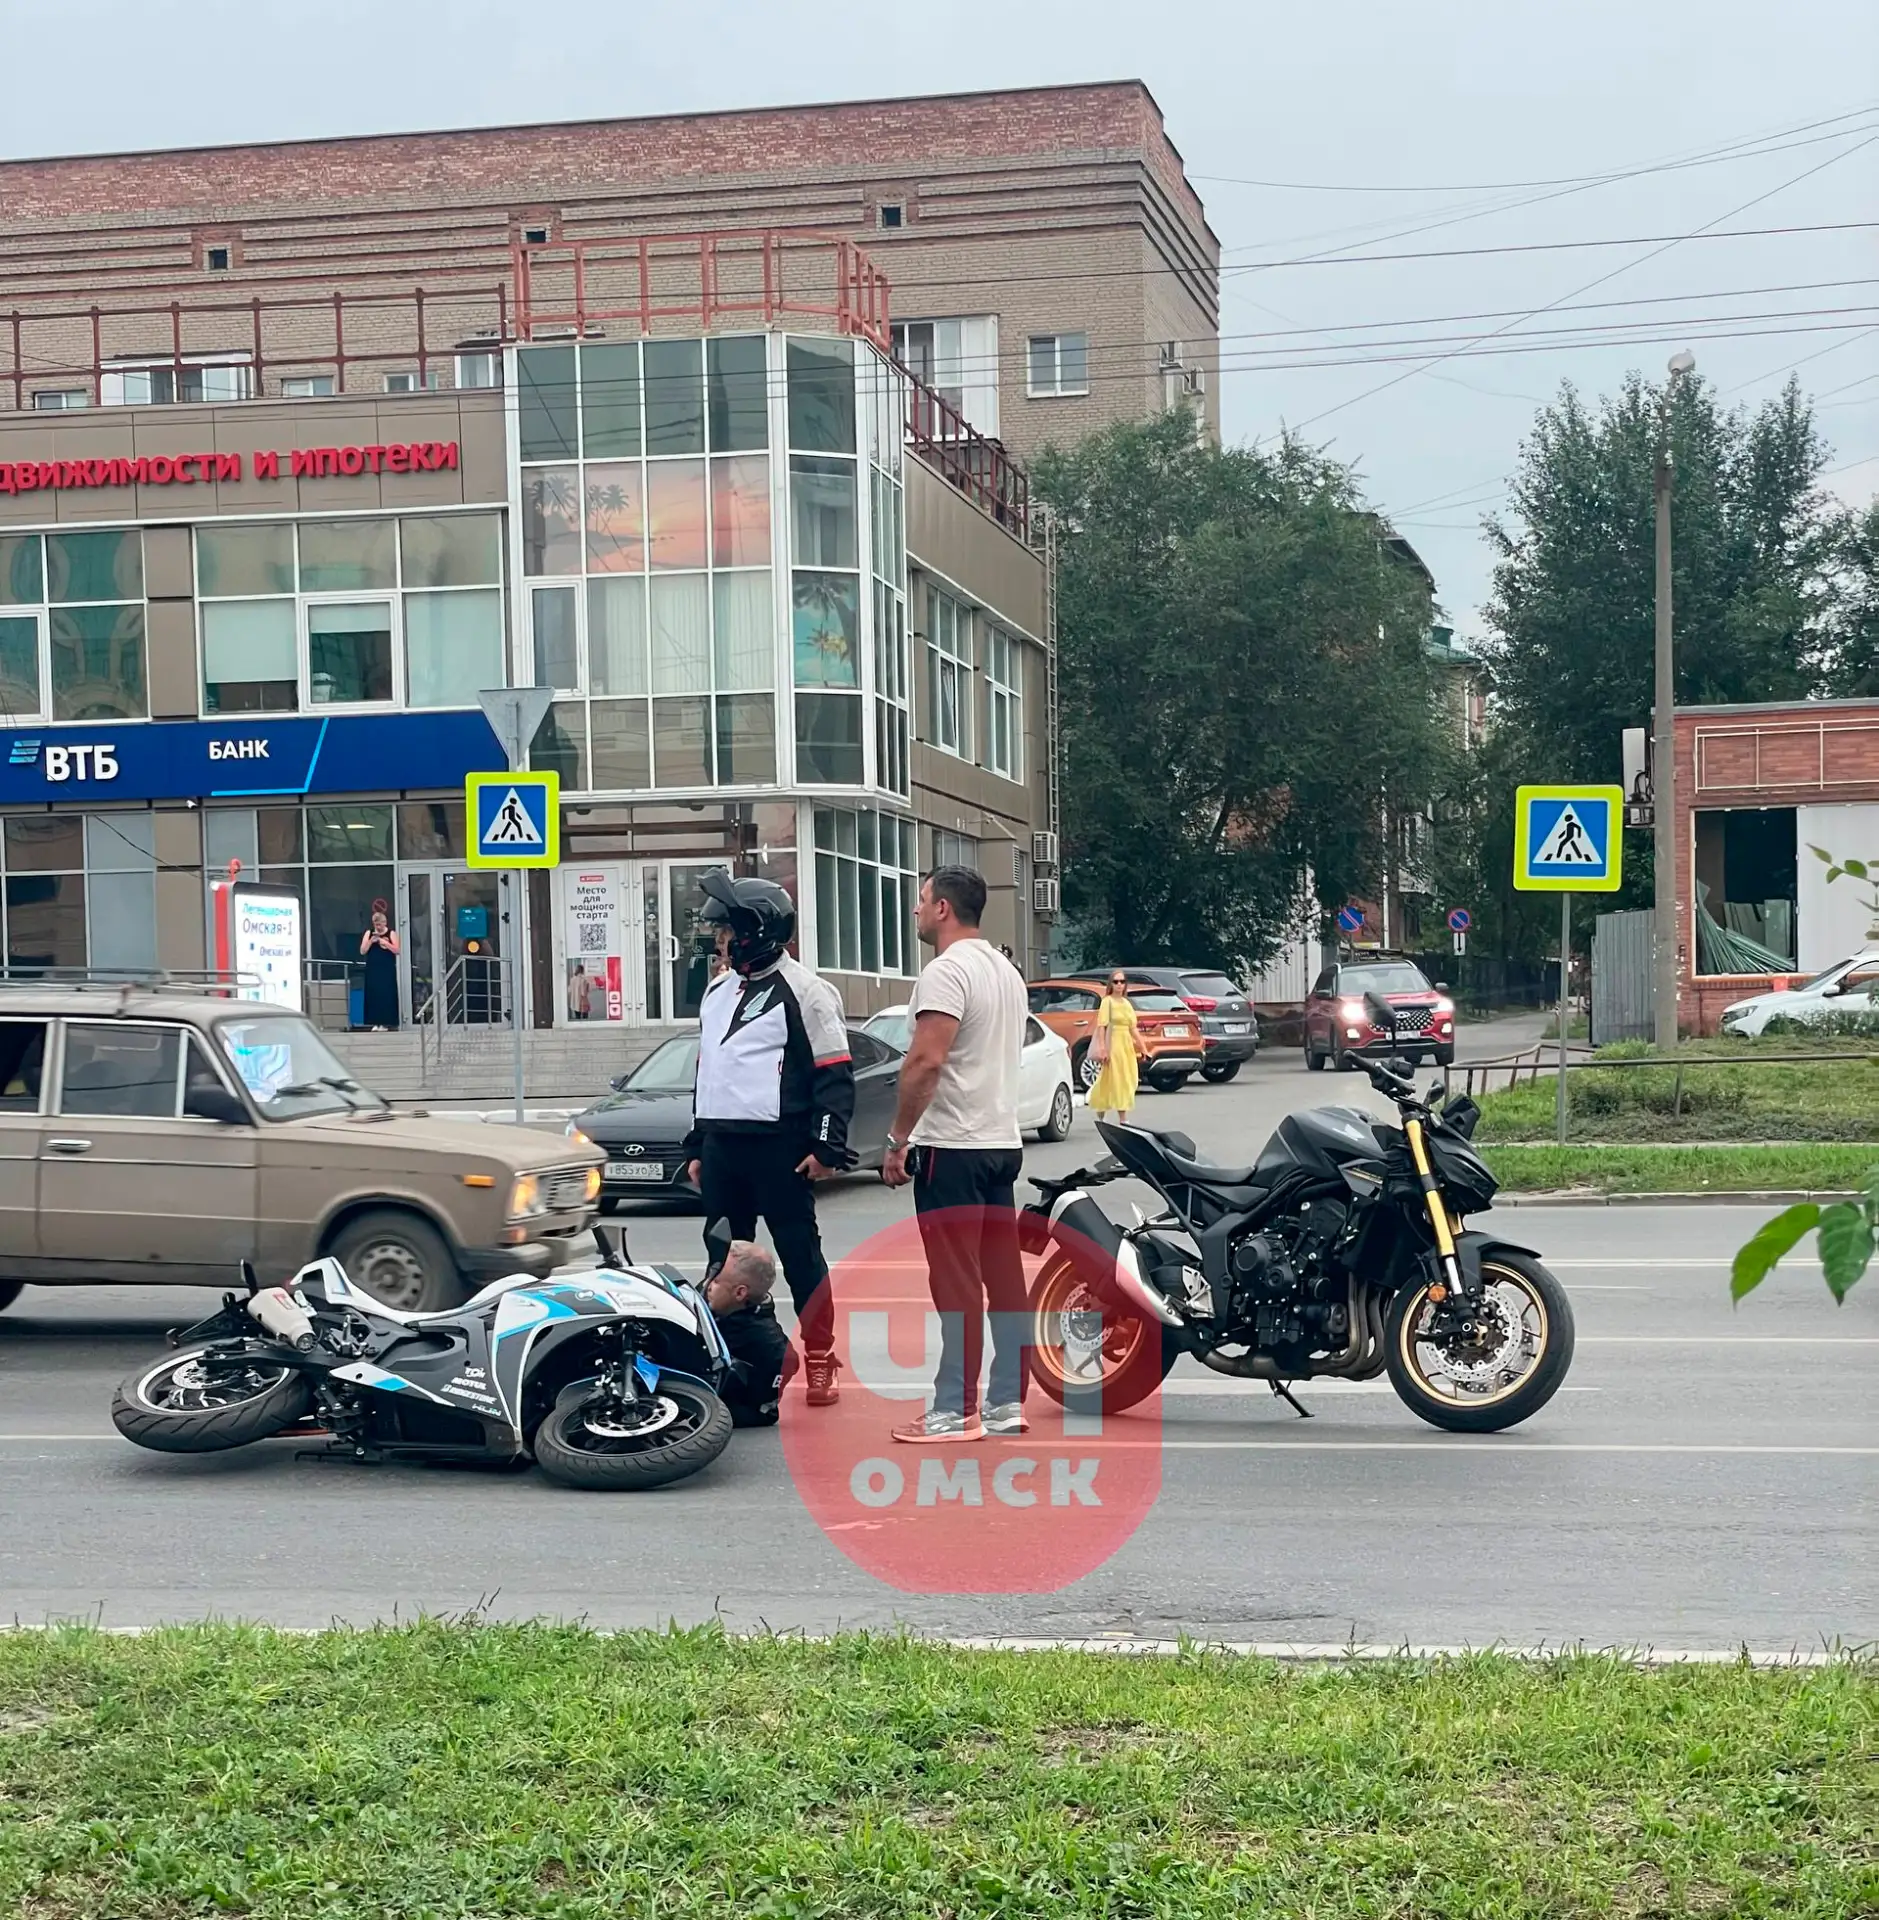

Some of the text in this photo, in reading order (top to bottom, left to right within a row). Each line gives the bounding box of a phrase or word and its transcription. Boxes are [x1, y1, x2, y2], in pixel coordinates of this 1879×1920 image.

[254, 451, 279, 480] и
[291, 442, 459, 480] ипотеки
[208, 739, 270, 760] БАНК
[45, 744, 119, 782] ВТБ
[576, 886, 607, 894] Место
[583, 895, 601, 904] для
[570, 903, 615, 912] мощного
[576, 912, 609, 921] старта
[243, 918, 293, 936] Омская-1
